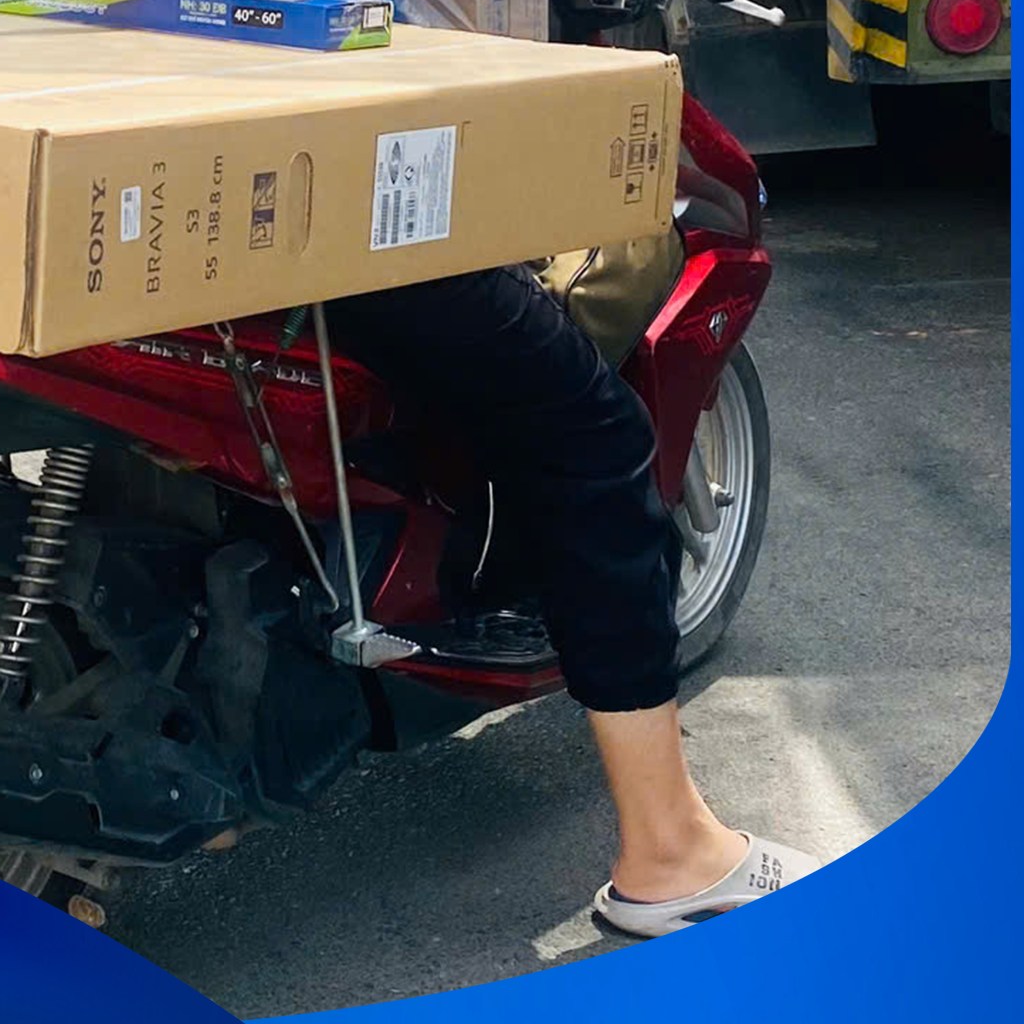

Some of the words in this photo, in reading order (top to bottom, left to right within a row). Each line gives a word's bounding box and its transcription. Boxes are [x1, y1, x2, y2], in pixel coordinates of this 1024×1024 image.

[152, 161, 167, 175] 3
[213, 155, 224, 185] cm
[186, 208, 200, 234] S3
[207, 190, 223, 246] 138.8
[87, 179, 107, 294] SONY
[146, 182, 166, 294] BRAVIA
[205, 255, 218, 281] 55
